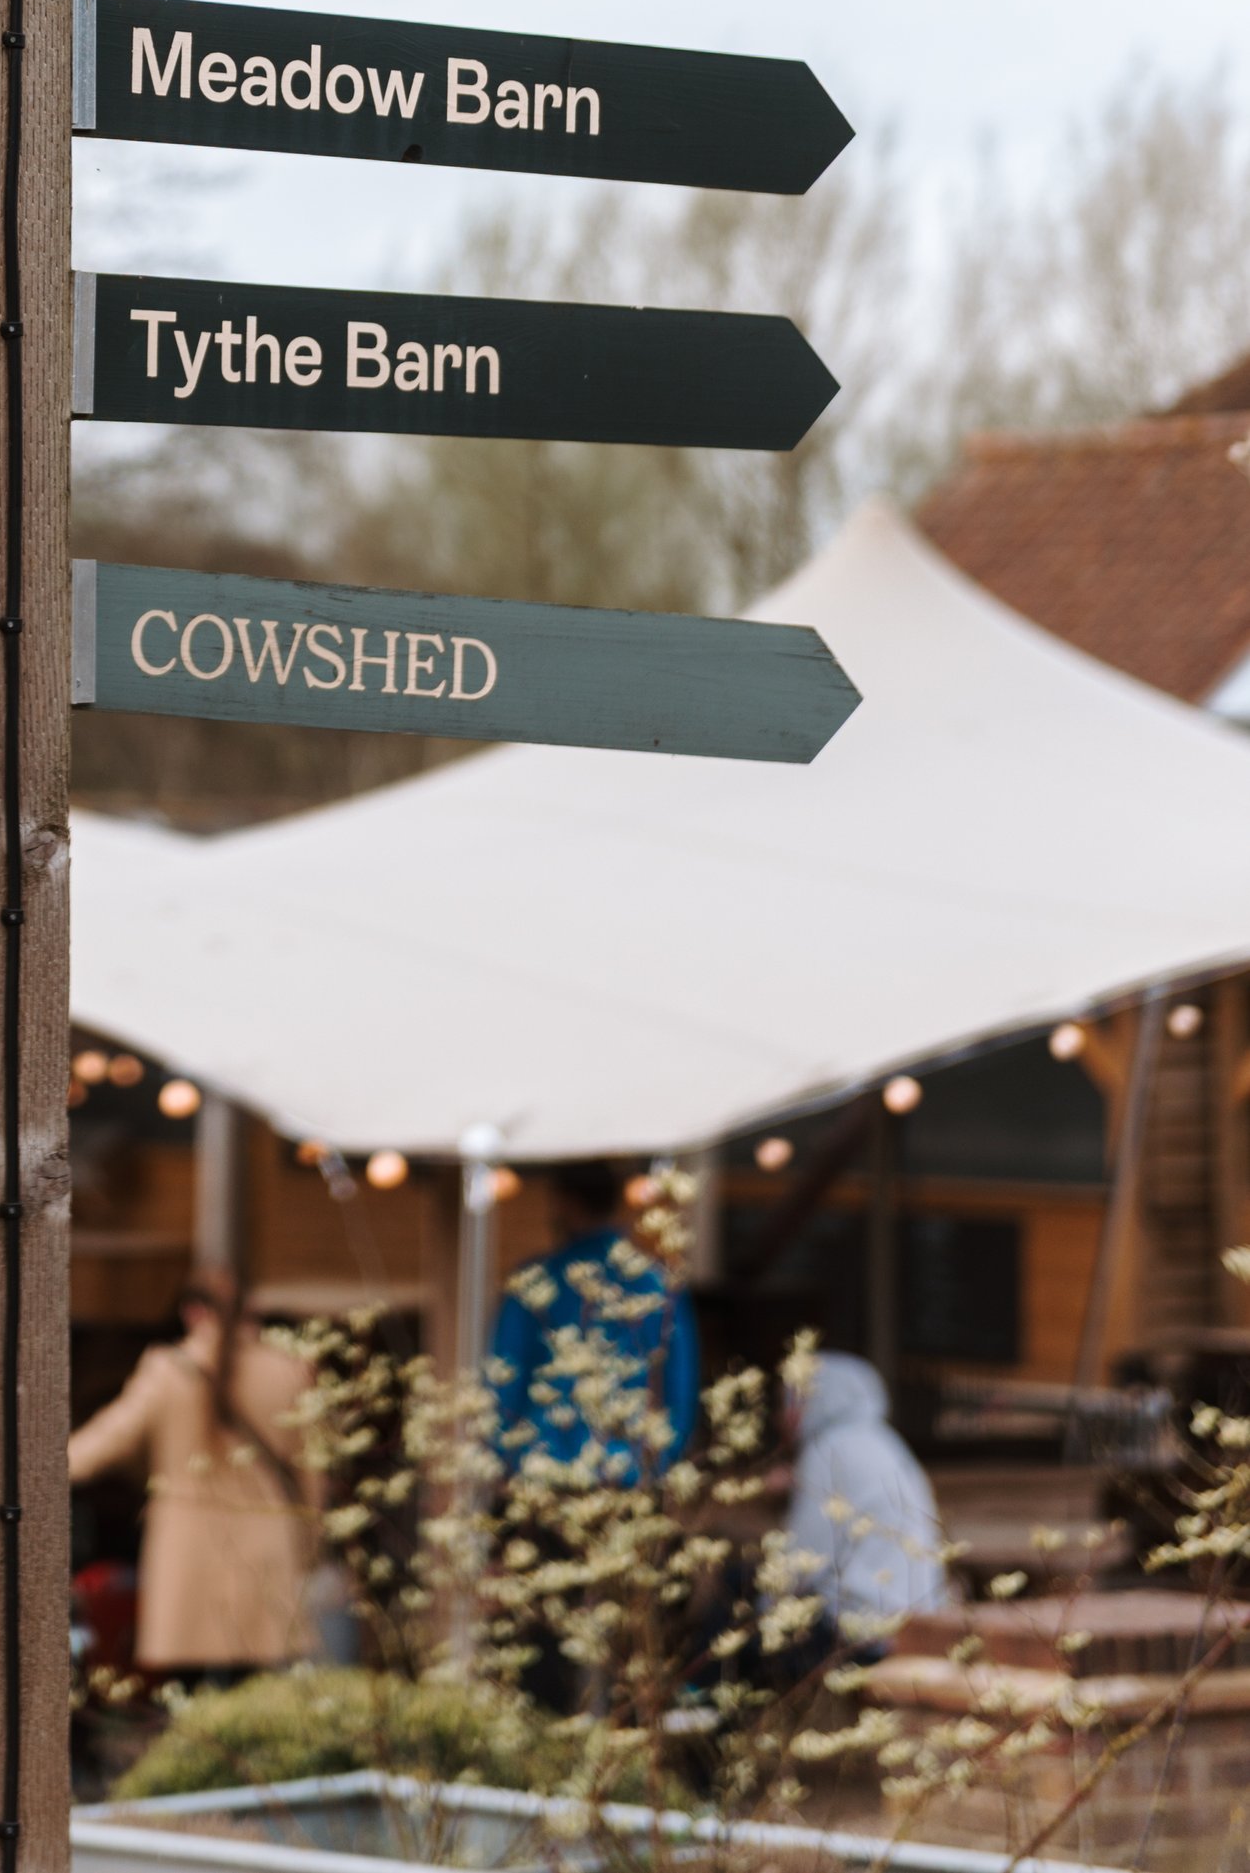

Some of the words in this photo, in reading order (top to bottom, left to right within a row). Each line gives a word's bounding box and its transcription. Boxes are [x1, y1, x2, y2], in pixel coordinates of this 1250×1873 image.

[131, 27, 425, 119] Meadow
[446, 57, 600, 136] Barn
[130, 308, 323, 399] Tythe
[346, 321, 500, 395] Barn
[131, 609, 498, 700] COWSHED
